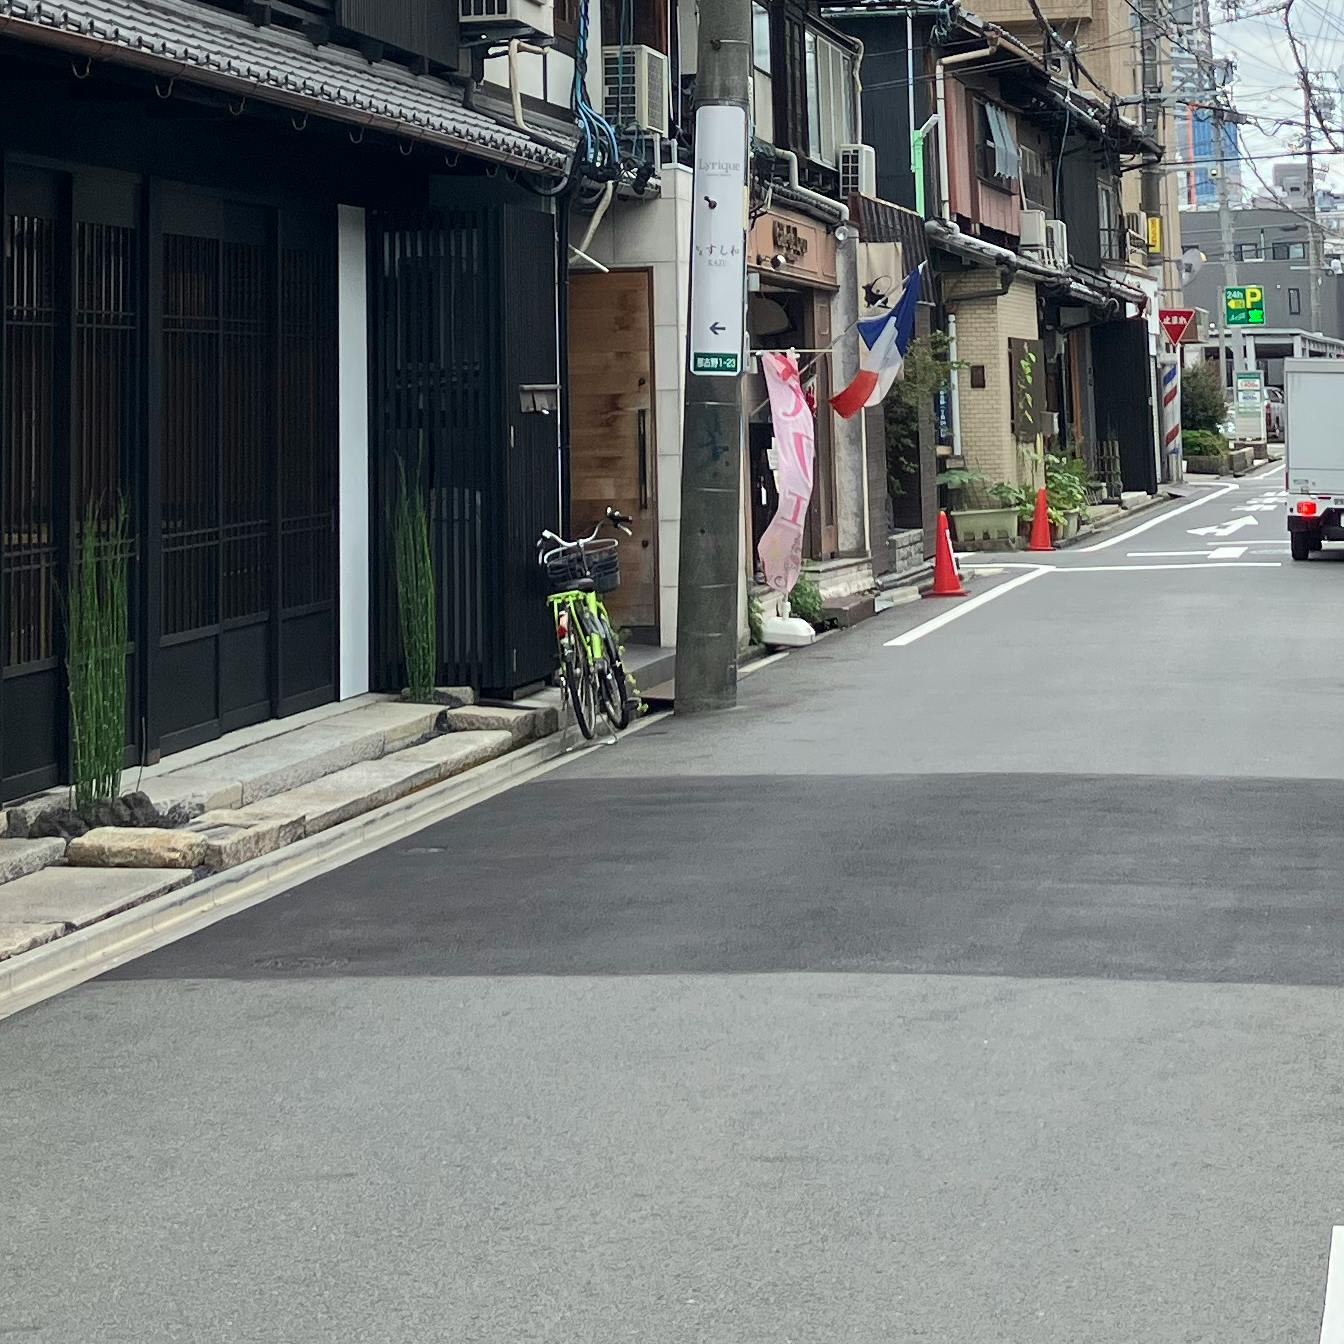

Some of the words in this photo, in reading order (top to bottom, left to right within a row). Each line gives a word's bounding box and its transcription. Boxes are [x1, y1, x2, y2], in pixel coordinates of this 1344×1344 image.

[698, 158, 741, 173] Lyrique
[1226, 290, 1244, 299] 24h
[1245, 288, 1262, 309] P
[1163, 315, 1188, 325] 止まれ
